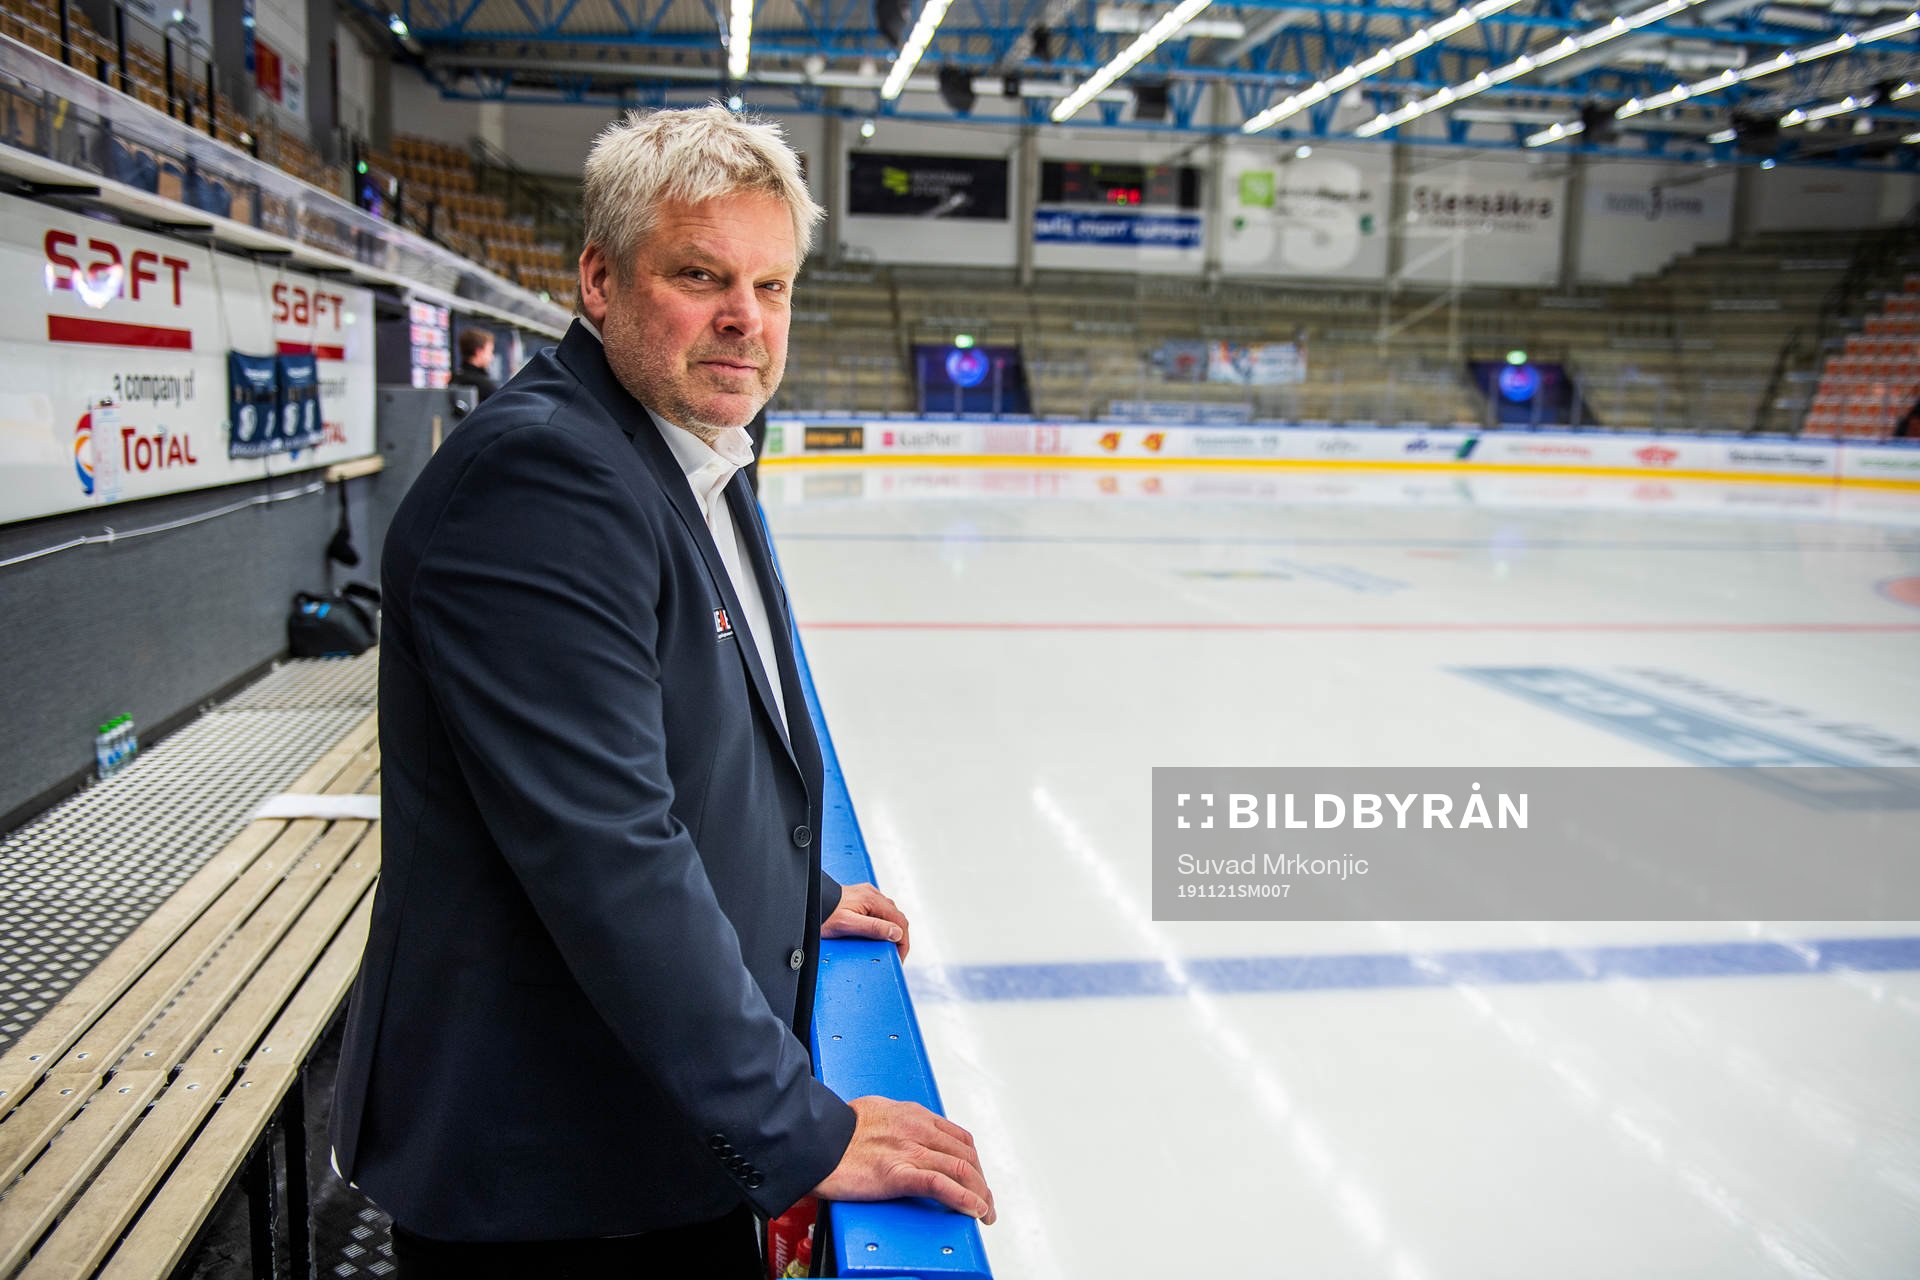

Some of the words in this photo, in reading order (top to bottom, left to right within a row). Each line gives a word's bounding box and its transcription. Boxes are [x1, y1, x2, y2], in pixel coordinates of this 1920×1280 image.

[113, 373, 122, 400] a
[125, 373, 181, 408] company
[183, 368, 195, 400] of
[120, 427, 197, 471] TOTAL
